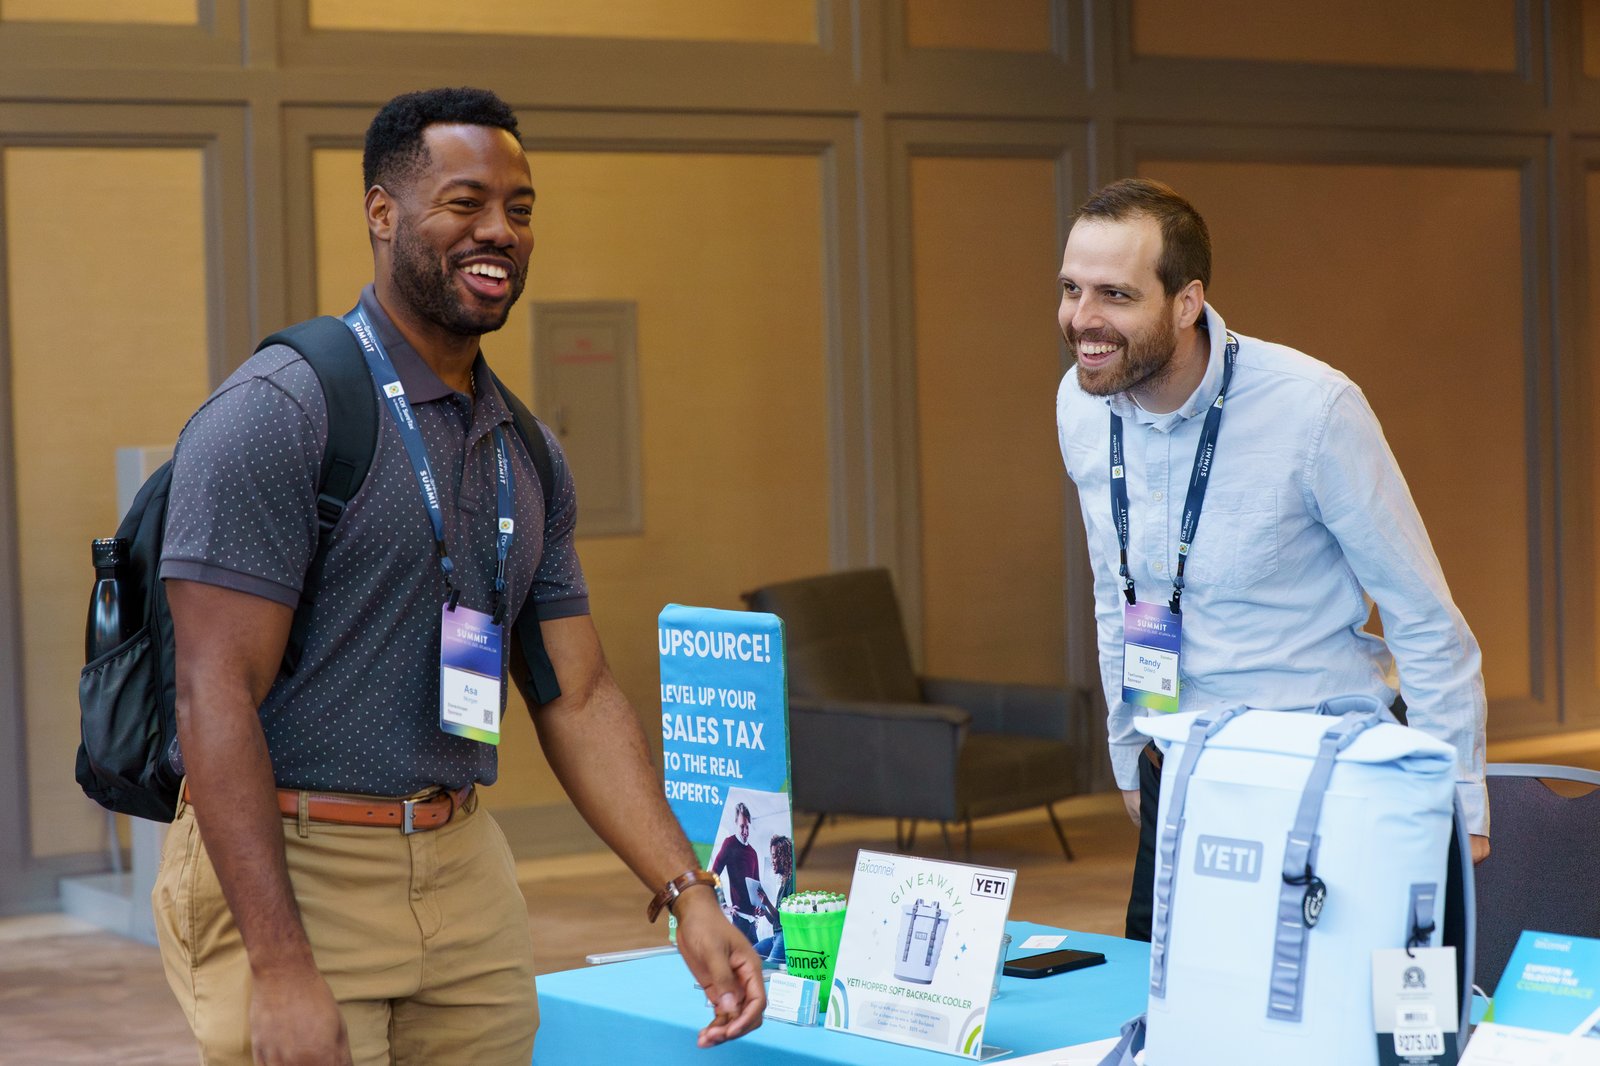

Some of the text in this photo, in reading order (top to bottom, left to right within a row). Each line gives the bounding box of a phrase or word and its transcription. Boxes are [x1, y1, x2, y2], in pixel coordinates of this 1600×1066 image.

[352, 321, 375, 353] SUMMIT
[496, 448, 506, 485] SUMMIT
[1200, 442, 1214, 477] SUMMIT
[419, 470, 439, 510] SUMMIT
[456, 628, 489, 645] SUMMIT
[1137, 619, 1168, 632] SUMMIT
[658, 628, 771, 663] UPSOURCE!
[1139, 656, 1161, 669] Randy
[464, 685, 478, 696] Asa
[660, 684, 757, 710] LEVEL UP YOUR
[661, 713, 766, 751] SALES TAX
[663, 751, 743, 779] TO THE REAL
[664, 780, 723, 806] EXPERTS.
[1201, 843, 1257, 874] YETI
[976, 878, 1006, 895] YETI
[786, 954, 828, 969] onnex
[846, 977, 972, 1009] YETI HOPPER SOFT BACKPACK COOLER
[1398, 1034, 1438, 1051] $275.00
